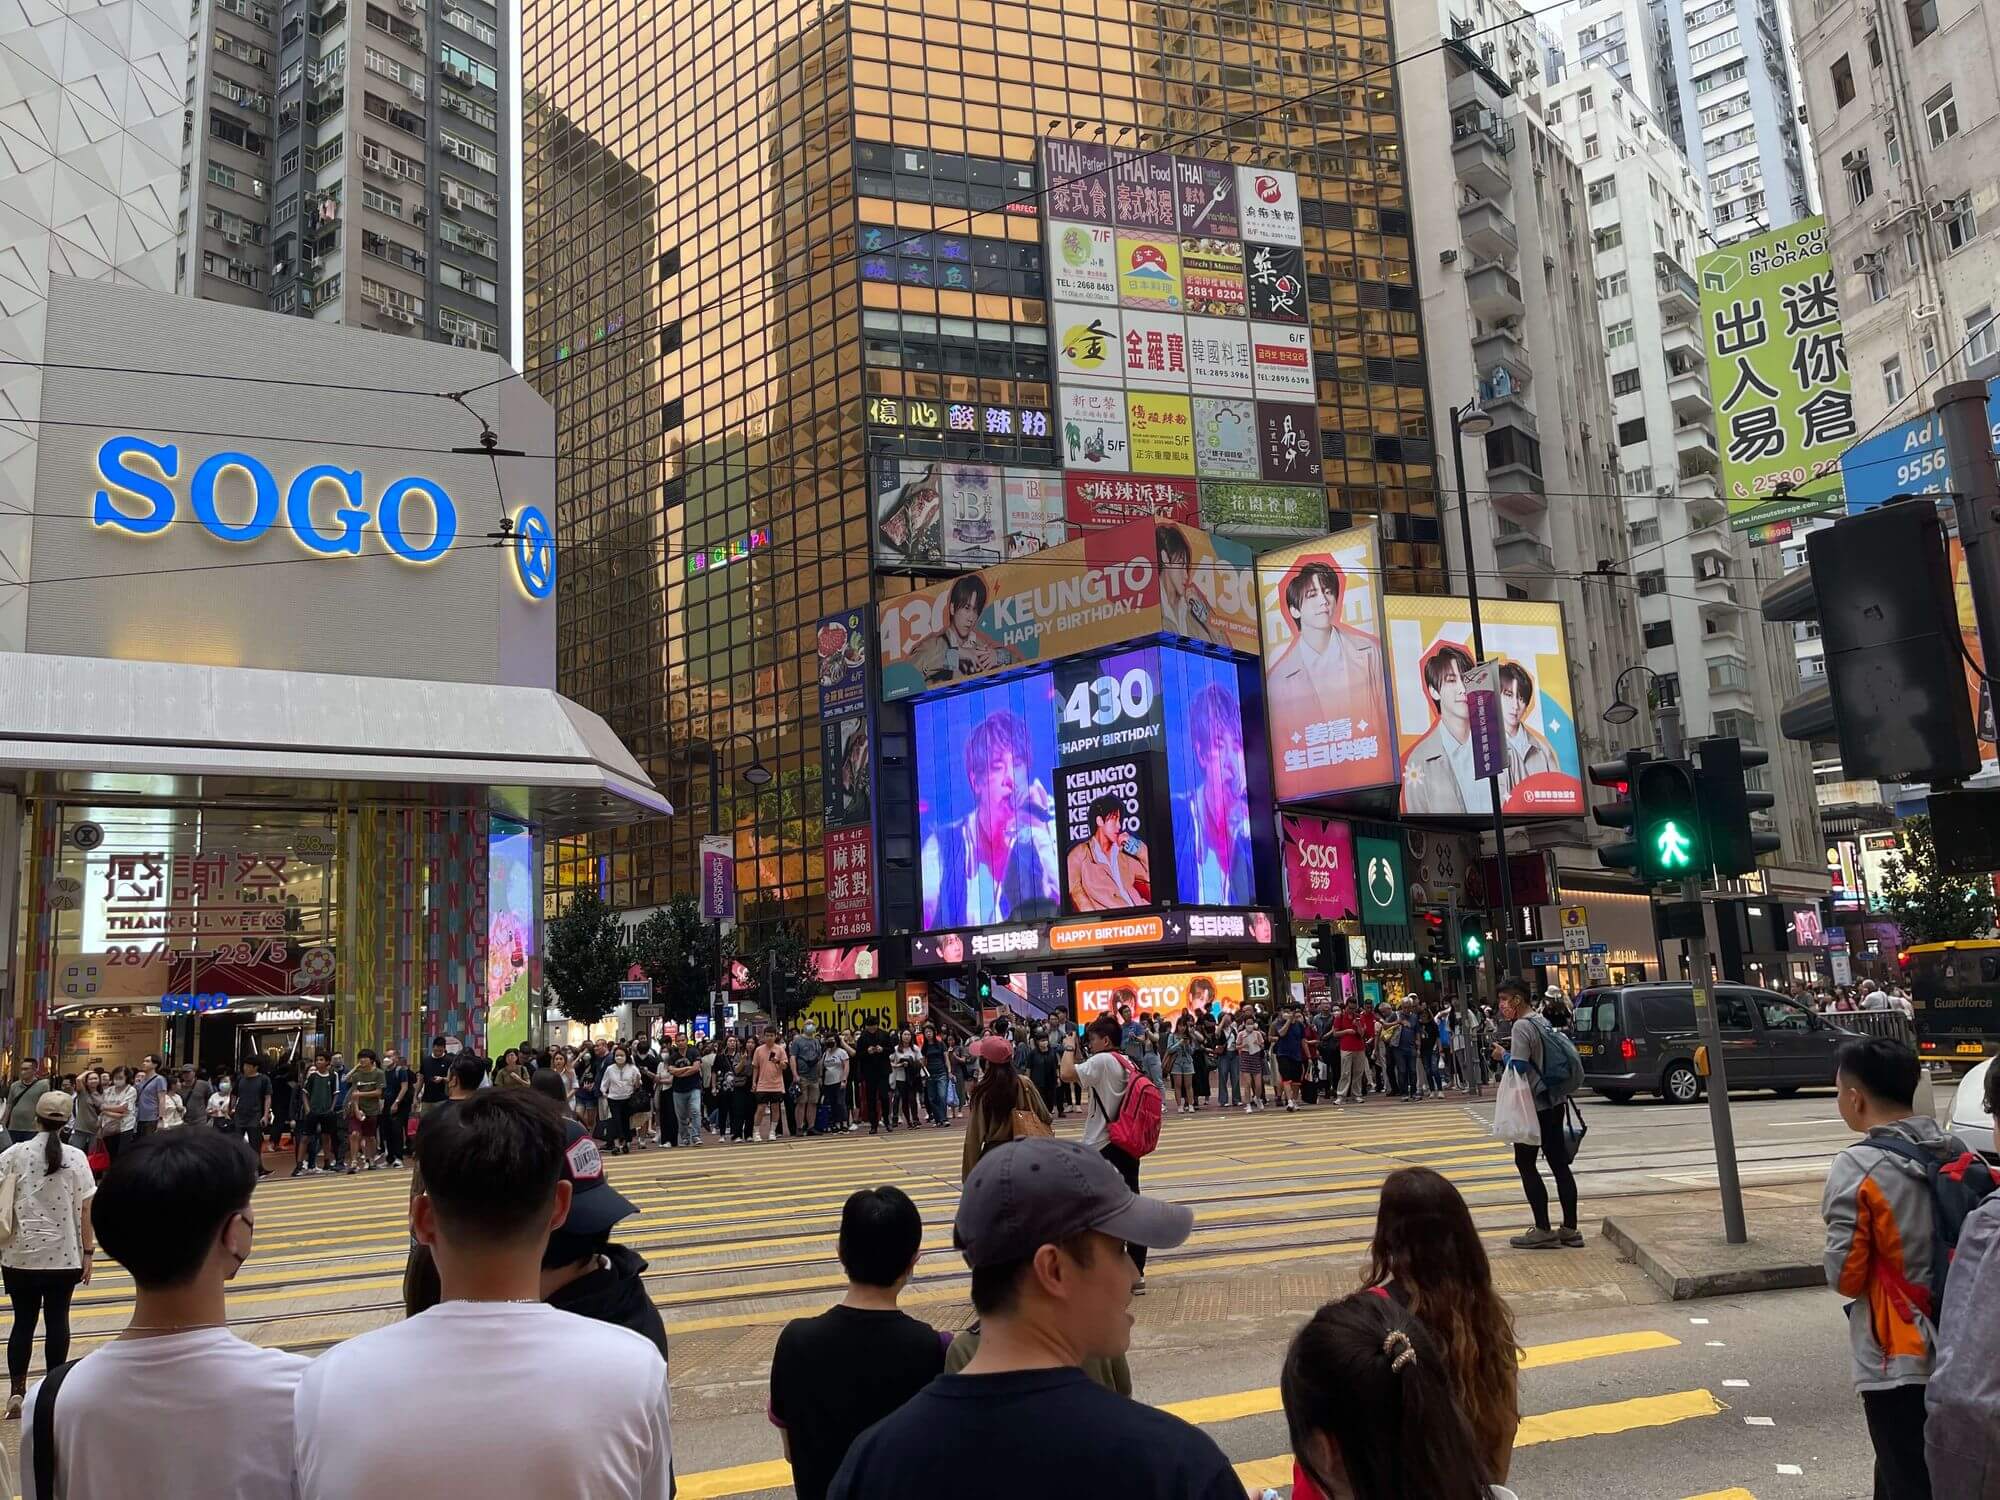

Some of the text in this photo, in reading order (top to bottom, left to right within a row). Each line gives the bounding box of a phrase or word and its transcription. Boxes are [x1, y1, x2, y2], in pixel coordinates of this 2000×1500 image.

[1047, 141, 1081, 175] THAI
[1113, 151, 1171, 184] THAI Food
[1177, 162, 1204, 185] THAI
[1182, 203, 1196, 217] 8/F
[1091, 229, 1111, 243] 7/F
[1749, 247, 1767, 262] IN
[1775, 240, 1788, 253] N
[1749, 241, 1829, 275] STORAG
[1187, 285, 1244, 300] 2881 8204
[1126, 328, 1186, 373] 金羅寶
[1288, 332, 1306, 344] 6/F
[1191, 337, 1249, 367] 韓國料理
[1715, 298, 1786, 463] 出入易
[1107, 439, 1126, 452] 5/F
[1174, 435, 1190, 447] 5/F
[1903, 420, 1932, 453] Ad
[1309, 464, 1321, 475] 5F
[1753, 467, 1805, 493] 2580
[1897, 448, 1946, 487] 9556
[881, 480, 893, 488] 3F
[1093, 480, 1174, 504] 麻辣派對
[93, 435, 457, 563] SOGO
[993, 555, 1154, 631] KEUNGTO
[1002, 592, 1144, 647] HAPPY BIRTHDAY!
[1063, 667, 1154, 729] 430
[1061, 724, 1161, 755] HAPPY BIRTHDAY
[1283, 735, 1378, 773] 生日快樂
[1066, 762, 1137, 789] KEUNGTO
[833, 843, 867, 872] 麻辣
[103, 851, 289, 902] 感謝祭
[833, 870, 868, 899] 派對
[1309, 870, 1331, 890] 莎莎
[106, 913, 286, 930] THANKFUL WEEKS
[831, 921, 872, 937] 2178 4898
[1055, 922, 1157, 944] HAPPY BIRTHDAY!!
[1188, 914, 1245, 937] 生日快樂
[971, 928, 1039, 955] 生日快樂
[1933, 996, 1993, 1009] Guardforce
